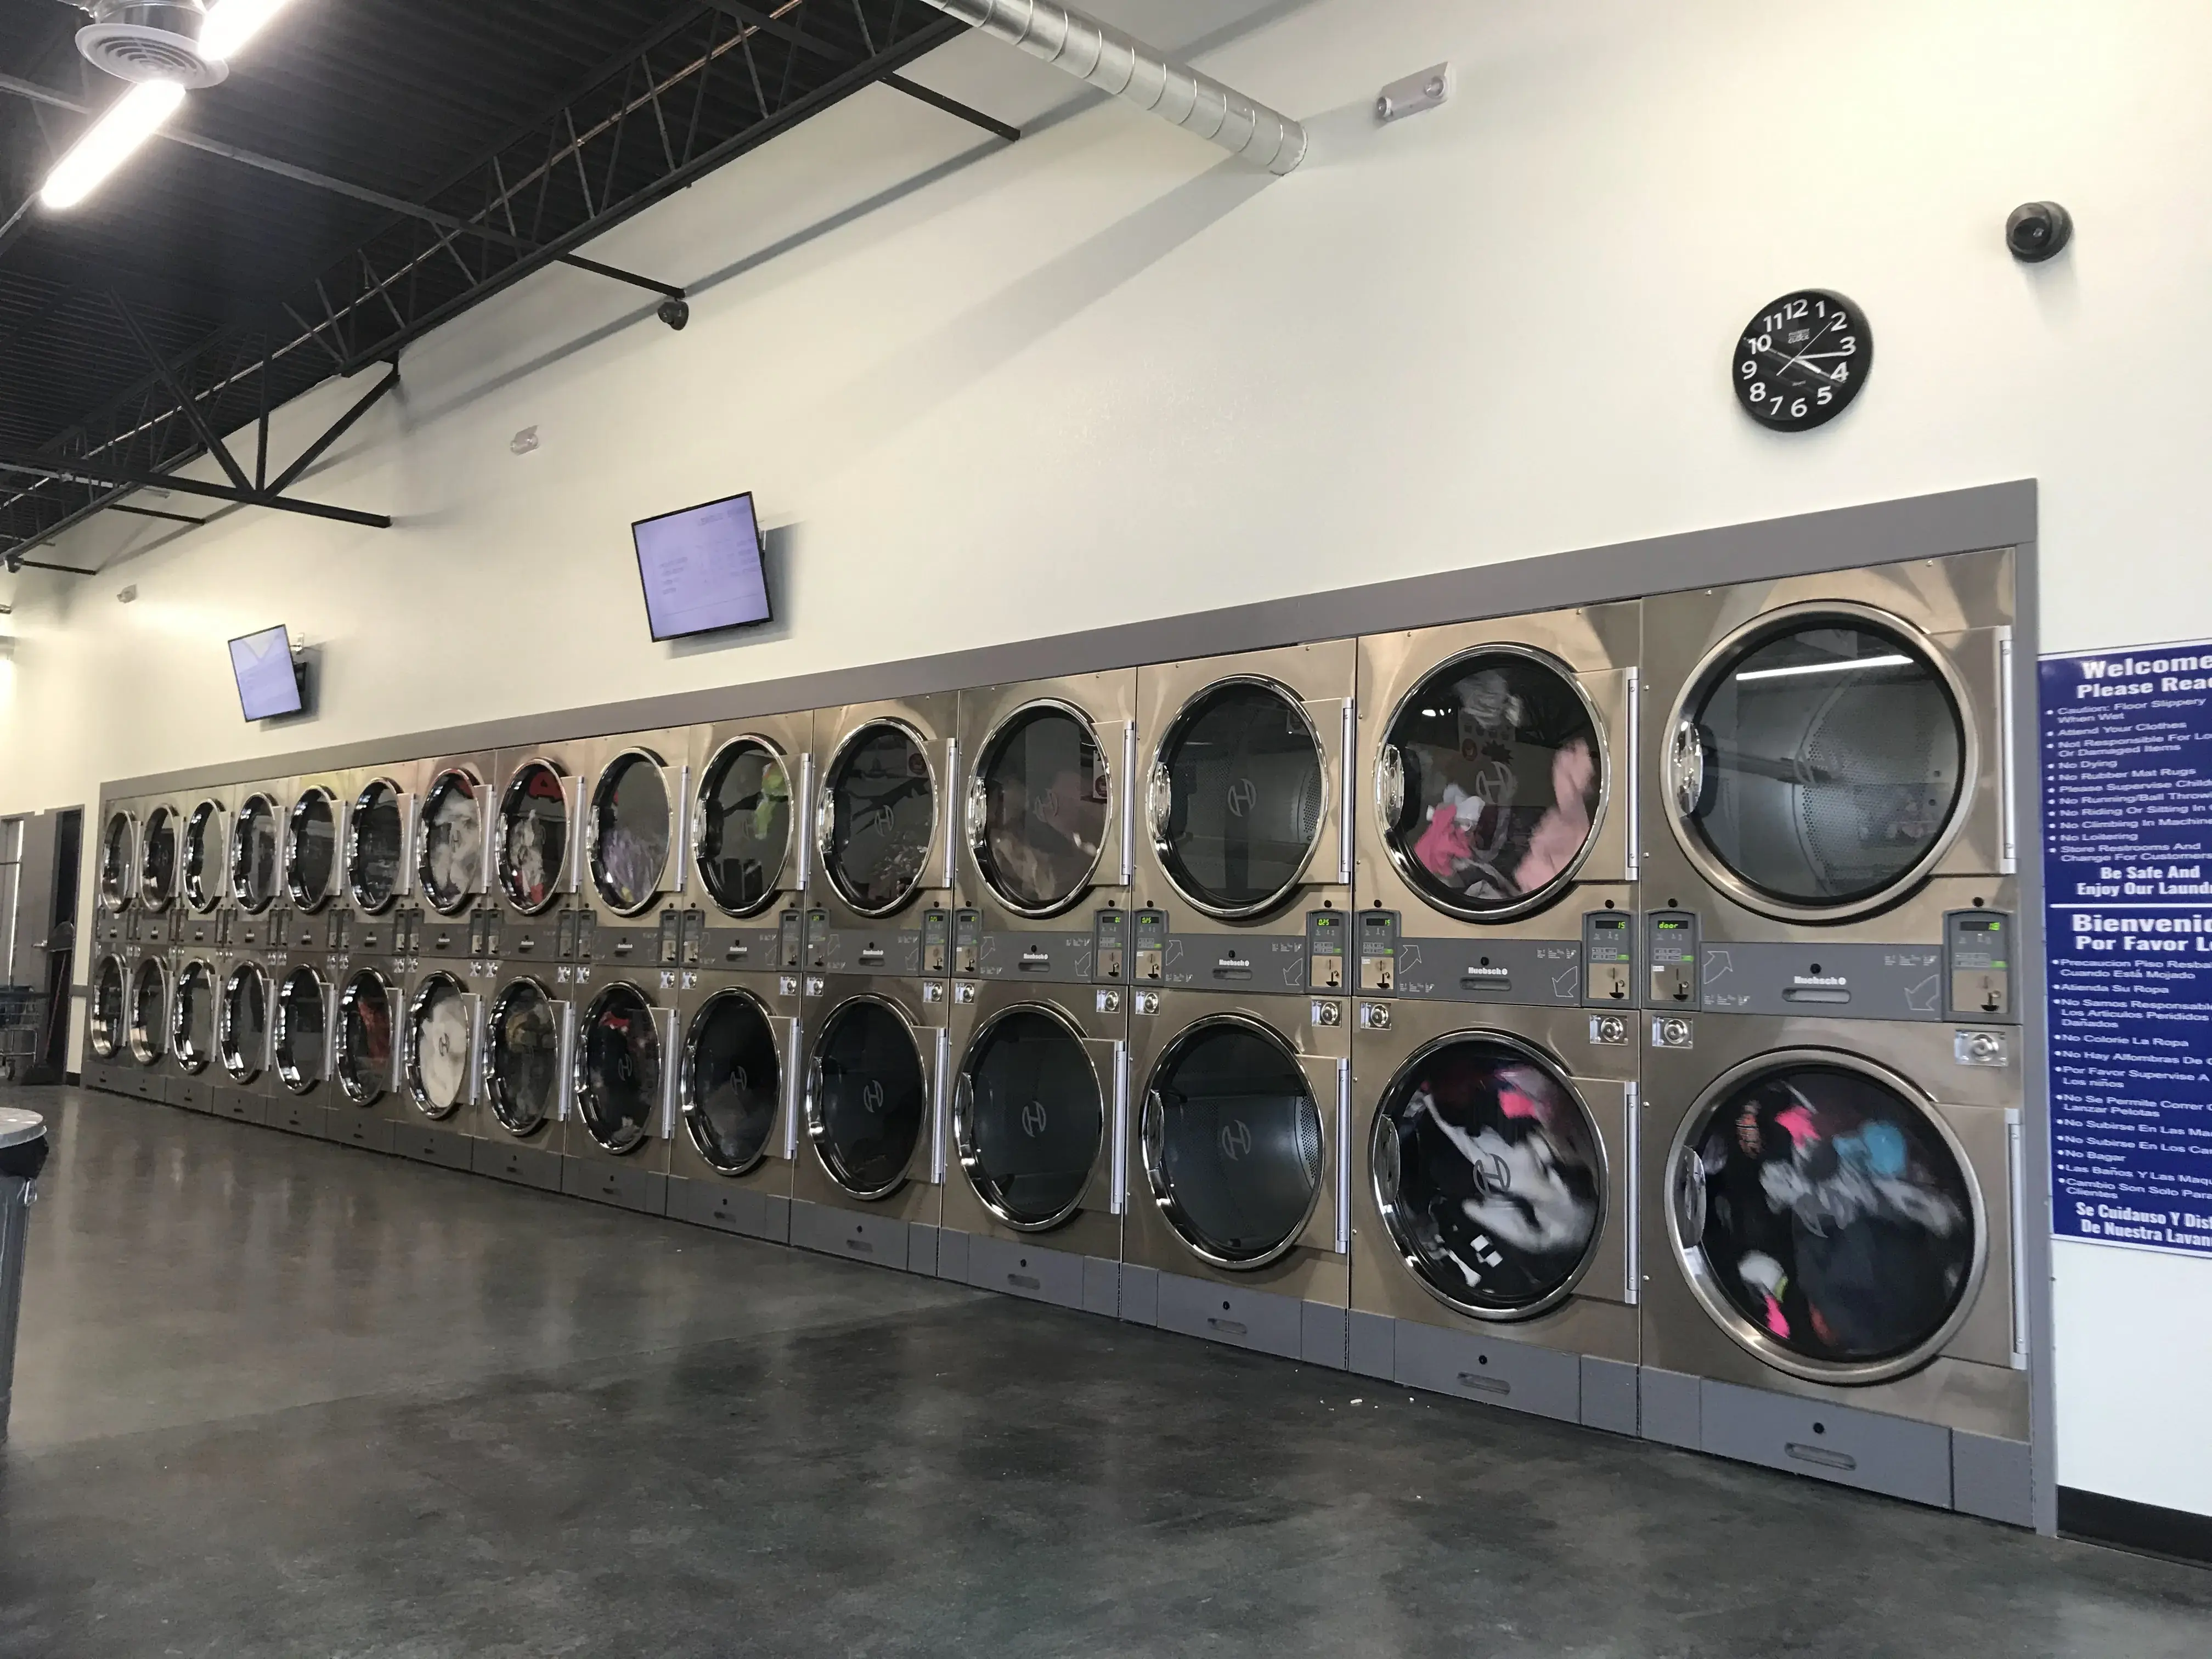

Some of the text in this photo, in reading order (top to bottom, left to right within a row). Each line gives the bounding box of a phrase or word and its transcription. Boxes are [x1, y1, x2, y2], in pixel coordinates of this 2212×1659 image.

[1784, 298, 1808, 320] 12
[1815, 301, 1825, 318] 1
[1763, 312, 1782, 332] 11
[1830, 311, 1847, 331] 2
[1748, 334, 1771, 354] 10
[1839, 336, 1856, 356] 3
[1741, 360, 1757, 380] 9
[1830, 361, 1849, 383] 4
[1750, 382, 1766, 402] 8
[1817, 386, 1832, 405] 5
[1770, 396, 1784, 415] 7
[1791, 398, 1808, 417] 6
[2080, 655, 2212, 679] Welcome
[2077, 677, 2212, 698] Please Rea
[2151, 698, 2207, 708] Slippery
[2058, 727, 2100, 736] Attend
[2136, 723, 2187, 731] Clothes
[2084, 736, 2164, 747] Responsible
[2078, 746, 2141, 756] Damaged
[2106, 782, 2172, 791] Supervise
[2147, 805, 2188, 814] Sitting
[2101, 865, 2200, 879] Be Safe And
[2076, 883, 2120, 897] Enjoy
[2124, 882, 2154, 894] Our
[2075, 935, 2117, 950] Por
[2123, 935, 2188, 951] Favor
[2061, 969, 2111, 977] Cuando
[2146, 970, 2196, 980] Mojado
[2134, 985, 2169, 994] Ropa
[2130, 1000, 2212, 1009] Responsabl
[2061, 1019, 2118, 1028] Dañados
[2153, 1038, 2188, 1047] Ropa
[2084, 1052, 2110, 1061] Hay
[2062, 1077, 2086, 1086] Los
[2089, 1067, 2125, 1076] Favor
[2129, 1070, 2194, 1081] Supervise
[2106, 1097, 2157, 1107] Permite
[2111, 1107, 2160, 1117] Pelotas
[2064, 1119, 2083, 1127] No
[2086, 1120, 2135, 1131] Subirse
[2138, 1124, 2157, 1132] En
[2159, 1126, 2185, 1135] Las
[2064, 1135, 2083, 1143] No
[2086, 1137, 2135, 1148] Subirse
[2139, 1142, 2158, 1150] En
[2160, 1143, 2185, 1152] Los
[2065, 1149, 2084, 1158] No
[2092, 1166, 2134, 1177] Baños
[2149, 1172, 2175, 1181] Las
[2066, 1178, 2212, 1199] Cambio Son Solo Para
[2066, 1187, 2118, 1199] Clientes
[2075, 1201, 2094, 1216] Se
[2169, 1211, 2180, 1226] Y
[2080, 1218, 2212, 1246] De Nuestra Lavan
